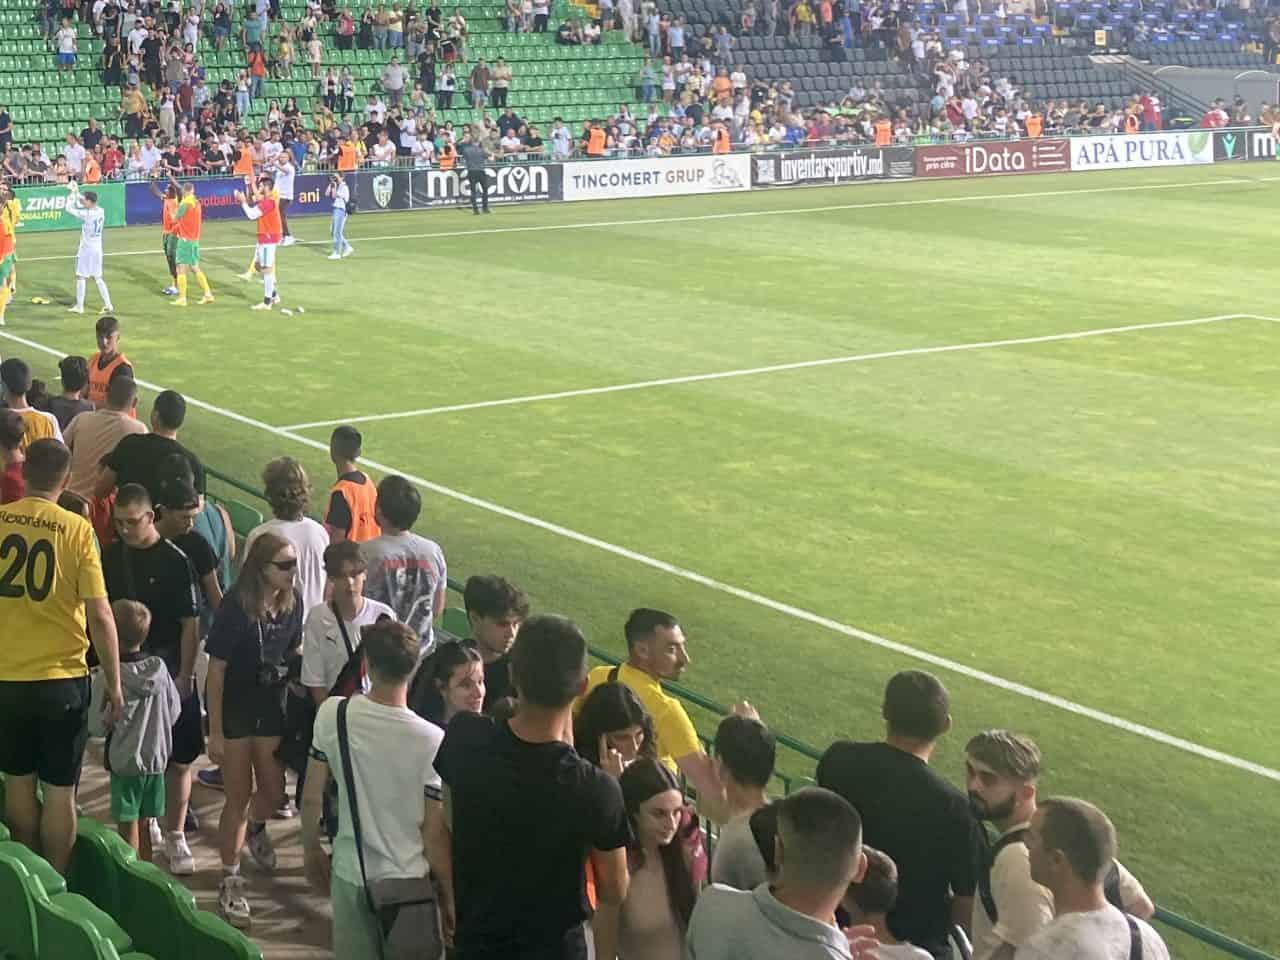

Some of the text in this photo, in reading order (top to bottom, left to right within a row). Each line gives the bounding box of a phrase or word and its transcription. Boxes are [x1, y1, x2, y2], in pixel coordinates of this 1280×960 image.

[780, 149, 884, 185] inventarsportiv.md
[964, 146, 1025, 174] iData
[572, 168, 705, 189] TINCOMERT GRUP
[298, 187, 320, 204] ani
